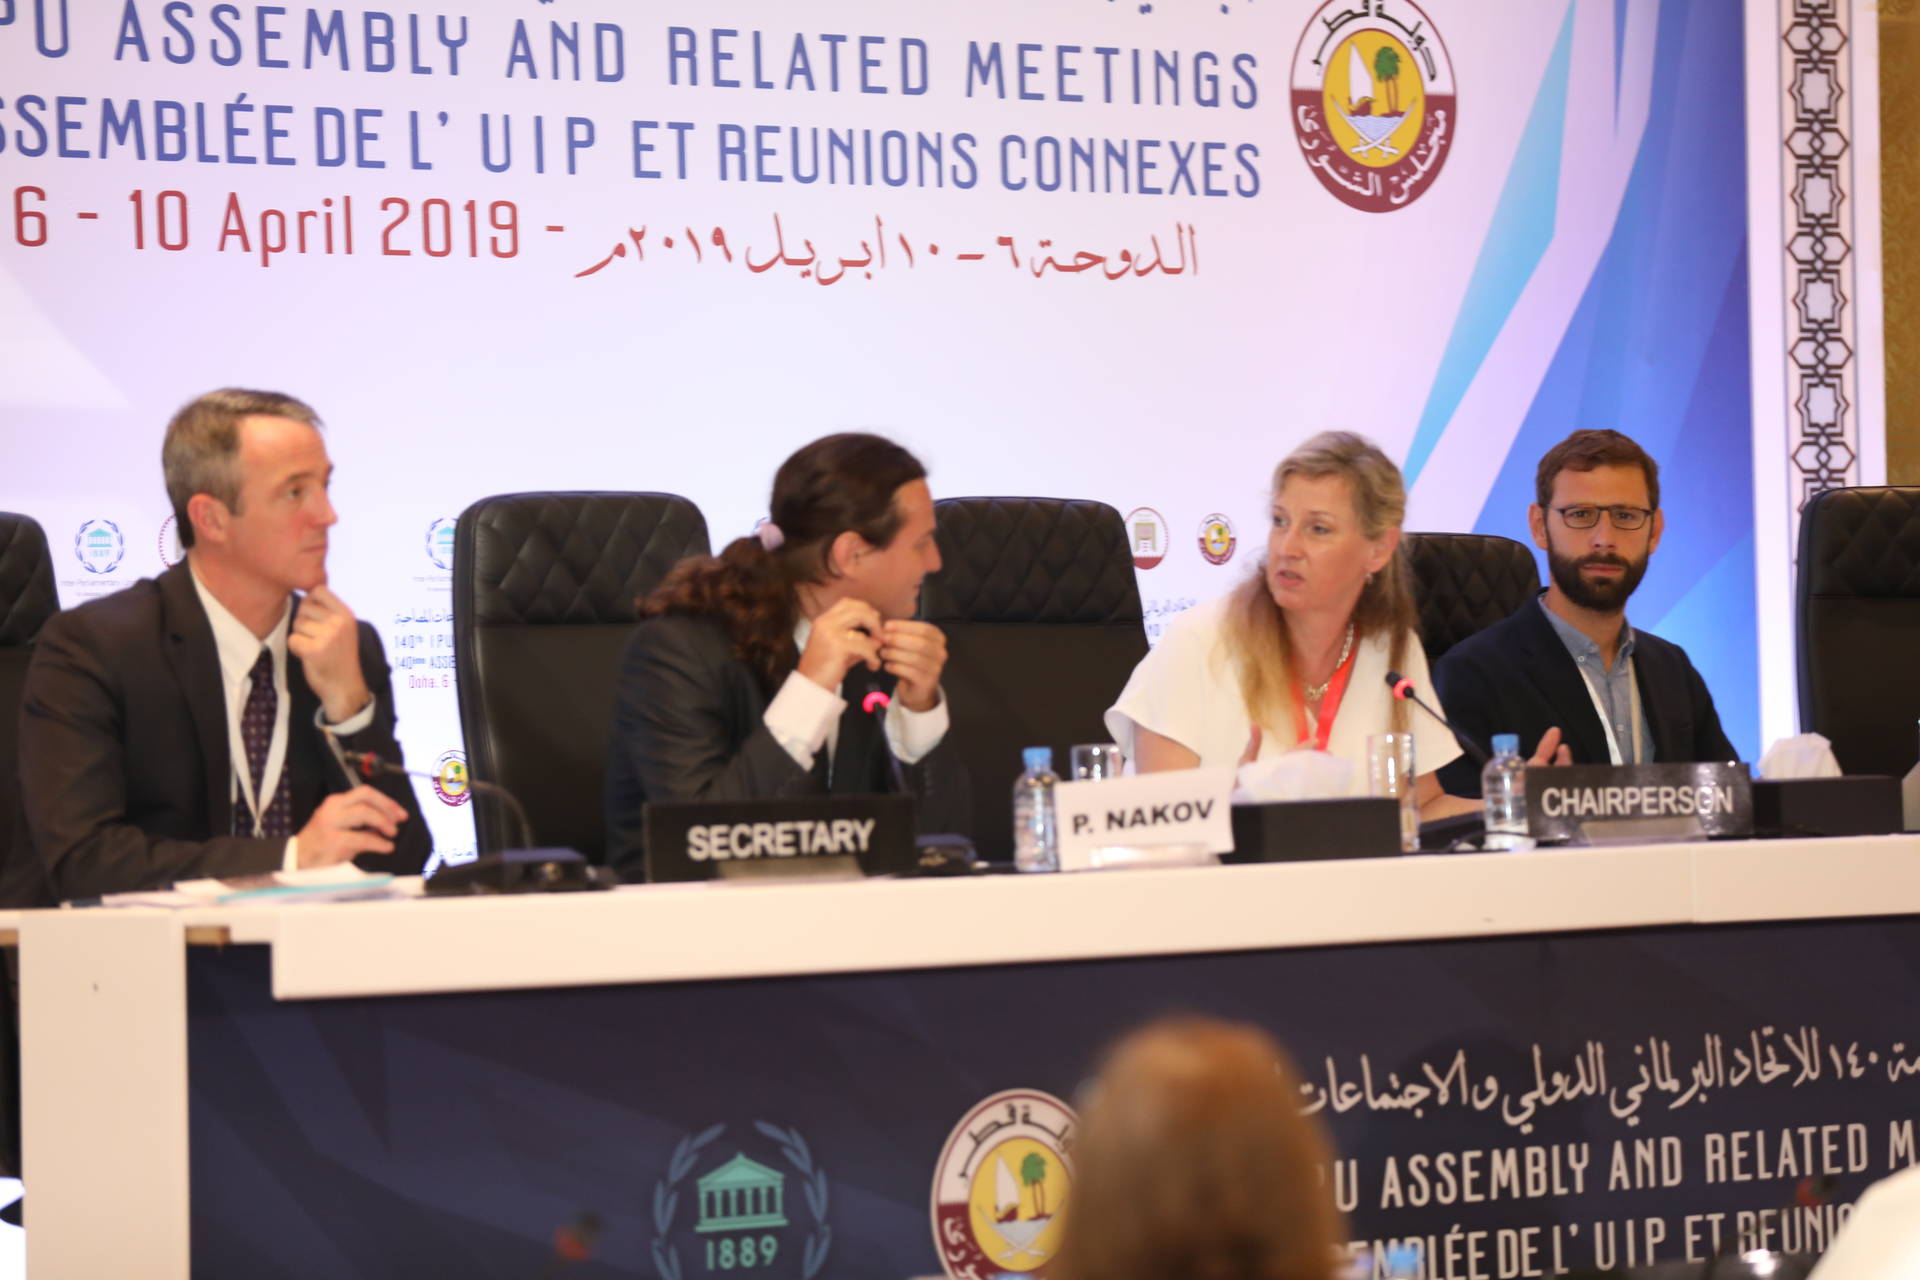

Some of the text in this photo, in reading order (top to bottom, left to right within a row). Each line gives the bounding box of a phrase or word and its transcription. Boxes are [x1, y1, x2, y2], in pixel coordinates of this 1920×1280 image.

[114, 0, 469, 76] ASSEMBLY
[505, 19, 625, 83] AND
[667, 26, 929, 97] RELATED
[965, 40, 1259, 110] MEETINGS
[0, 93, 297, 166] SEMBLÉE
[314, 106, 387, 169] DE
[631, 120, 696, 180] ET
[717, 122, 978, 190] REUNIONS
[1000, 134, 1261, 198] CONNEXES
[14, 185, 47, 247] 6
[129, 189, 188, 251] 10
[218, 191, 353, 268] April
[380, 196, 519, 259] 2019
[1030, 221, 1197, 280] الدوحة
[1072, 798, 1214, 835] P. NAKOV
[1541, 786, 1734, 817] CHAIRPERSON
[687, 818, 876, 862] SECRETARY
[1502, 1040, 1607, 1135] الدولي
[1380, 1143, 1589, 1209] ASSEMBLY
[1608, 1136, 1682, 1191] AND
[1704, 1122, 1868, 1184] RELATED
[706, 1236, 778, 1270] 1889
[1497, 1226, 1543, 1280] DE
[1684, 1212, 1726, 1264] ET
